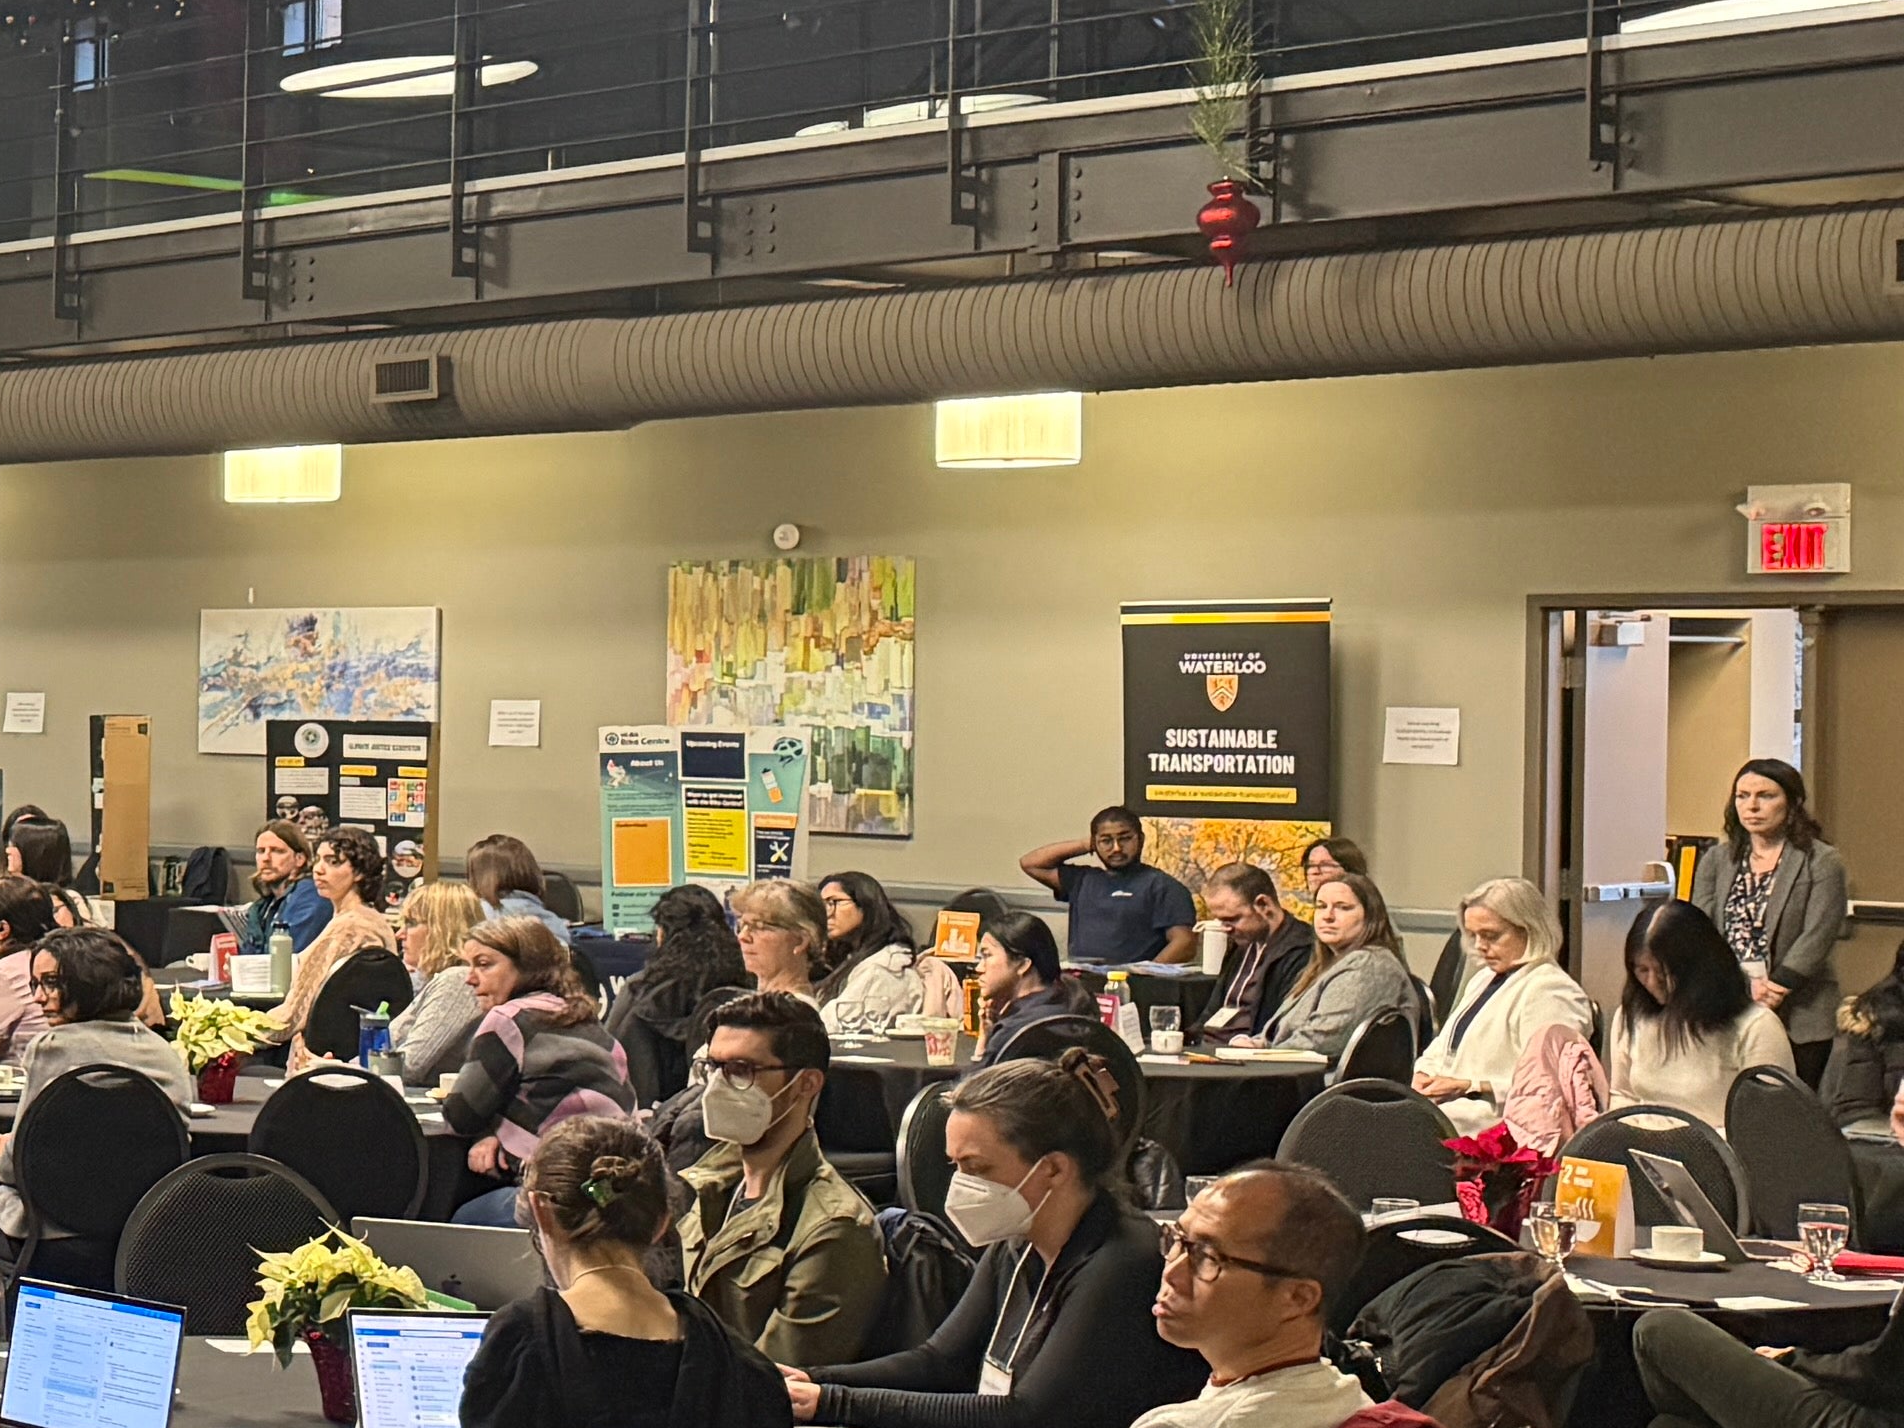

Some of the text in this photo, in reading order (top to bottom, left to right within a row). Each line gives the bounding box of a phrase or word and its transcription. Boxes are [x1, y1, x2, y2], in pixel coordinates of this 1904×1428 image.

[1762, 523, 1828, 570] EXIT
[1178, 660, 1267, 674] WATERLOO
[1184, 653, 1261, 661] UNIVERSITY OF
[1165, 728, 1278, 748] SUSTAINABLE
[1147, 753, 1295, 774] TRANSPORTATION
